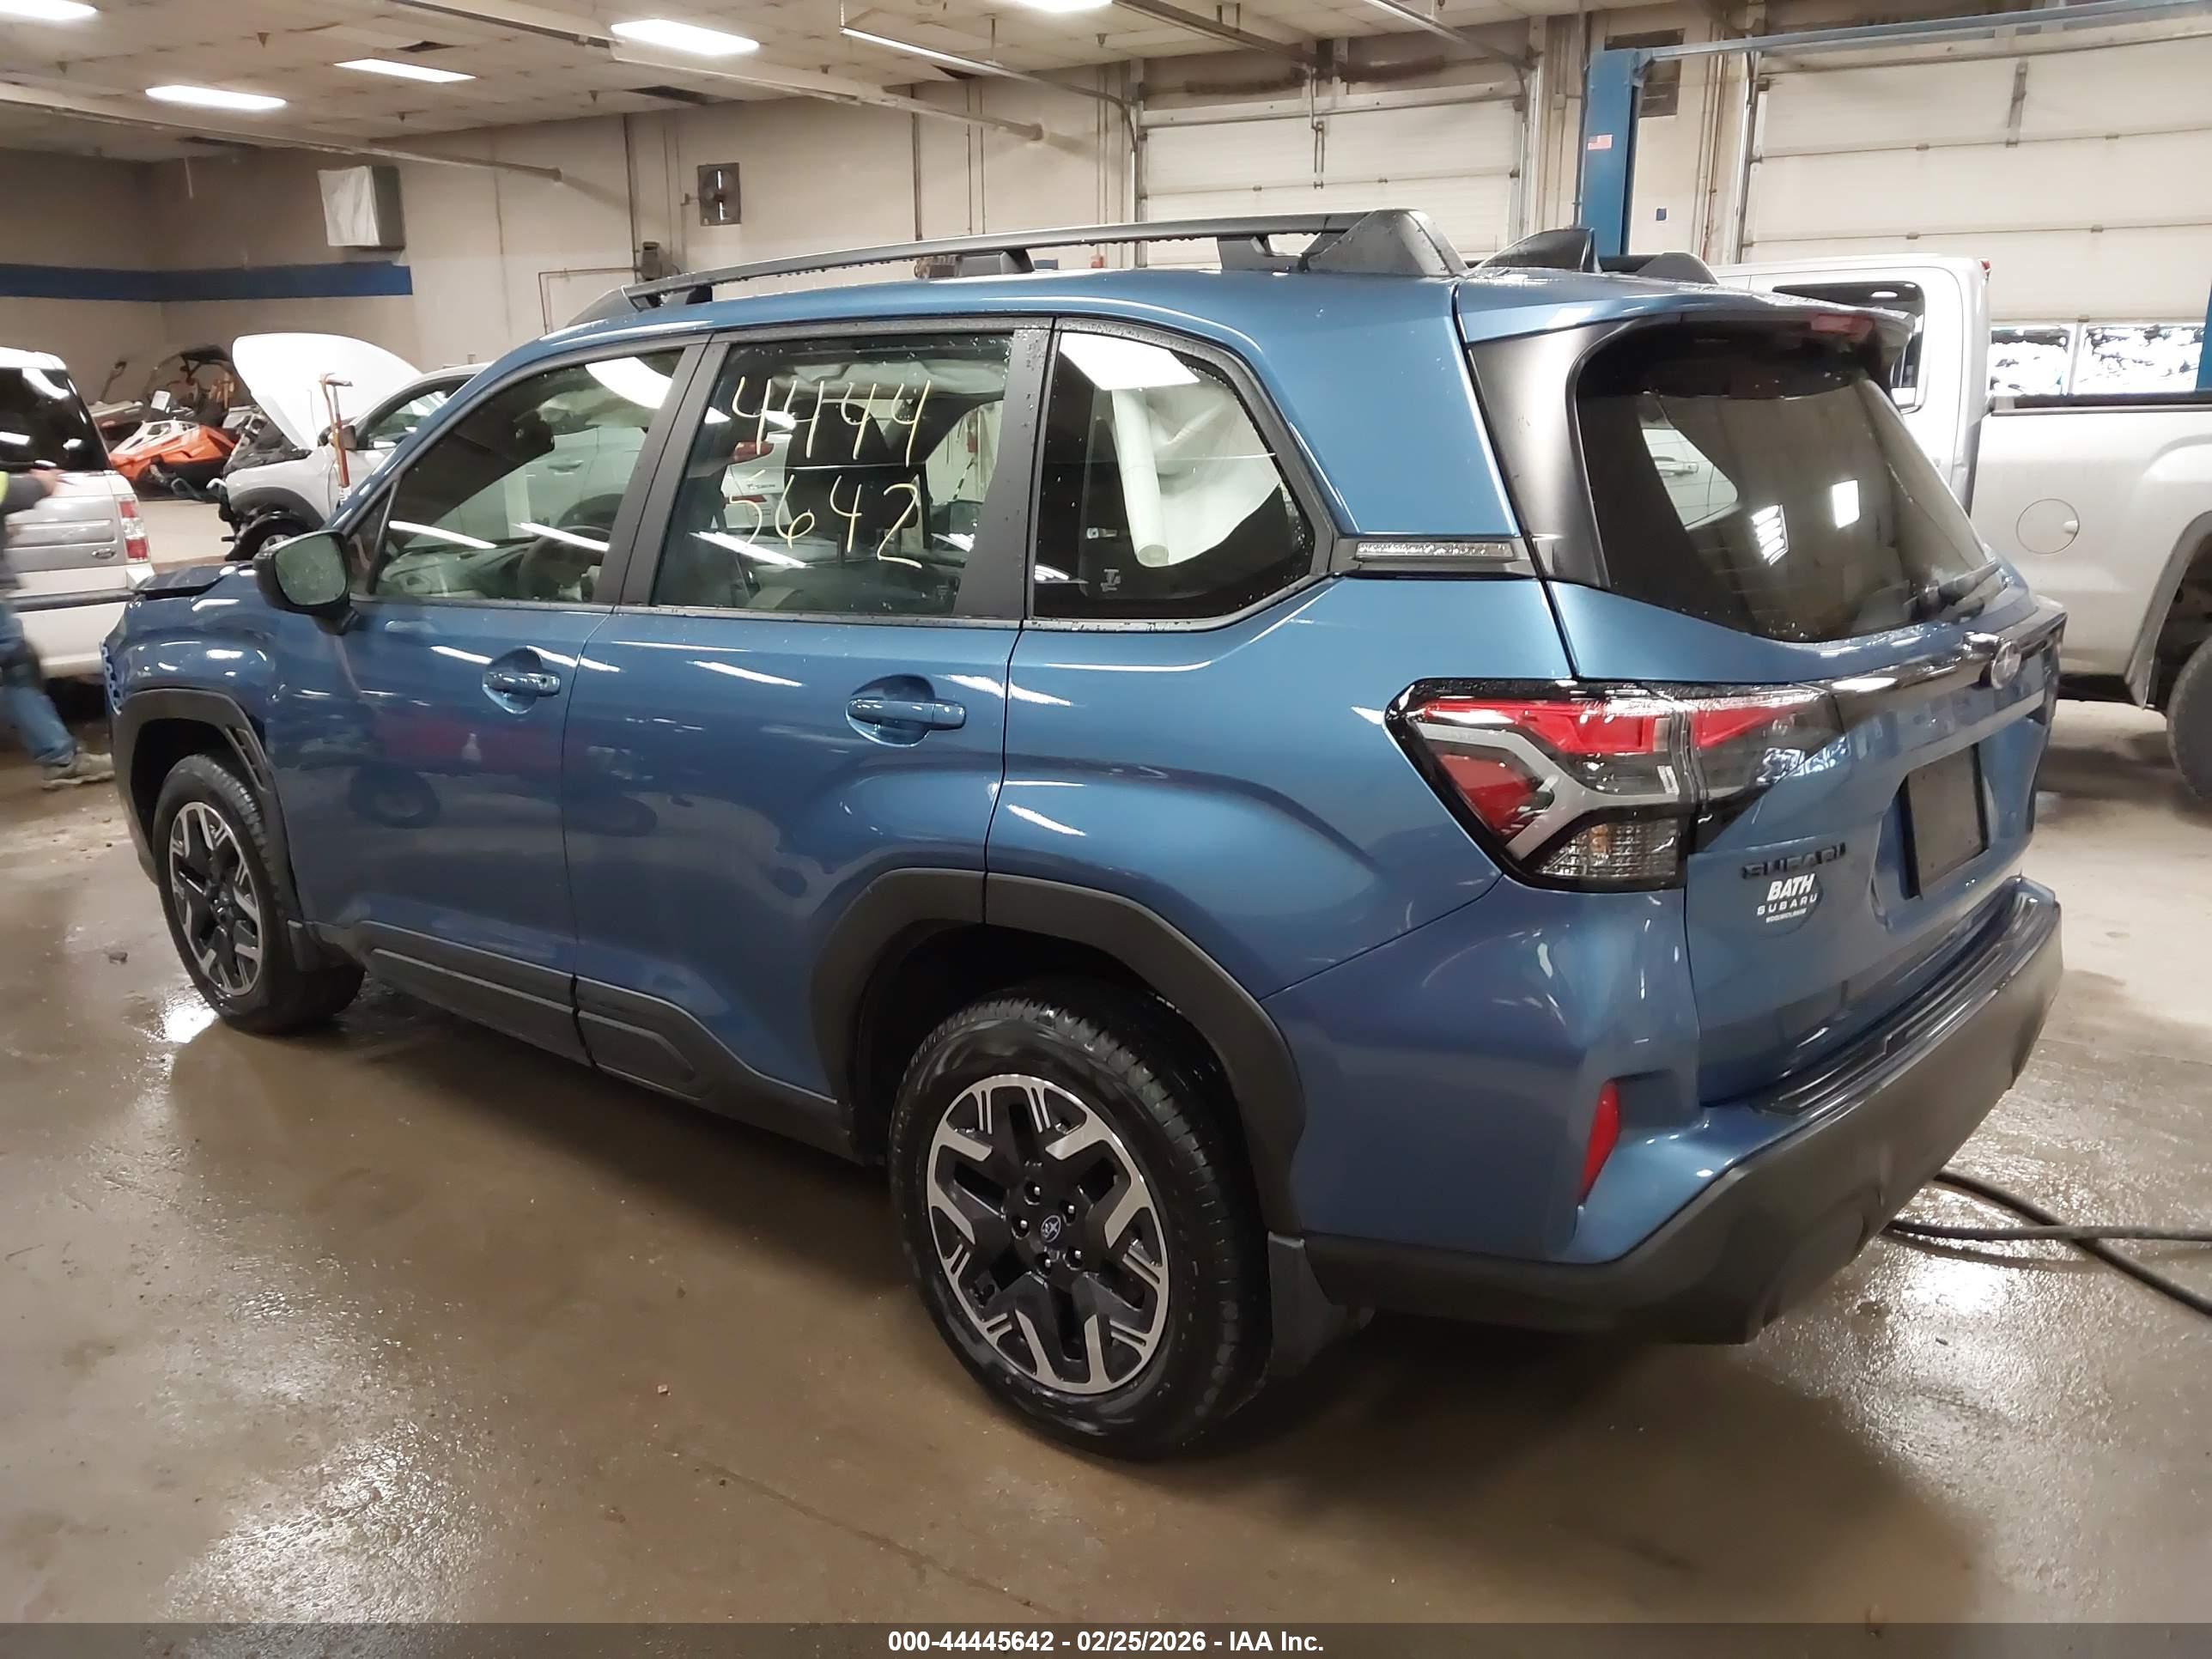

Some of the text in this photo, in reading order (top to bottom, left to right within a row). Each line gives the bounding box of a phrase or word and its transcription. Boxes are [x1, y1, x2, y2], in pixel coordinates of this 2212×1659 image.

[732, 375, 932, 467] 4444
[728, 469, 923, 568] 5642
[1757, 891, 1819, 916] SUBARU
[1766, 872, 1816, 902] BATH
